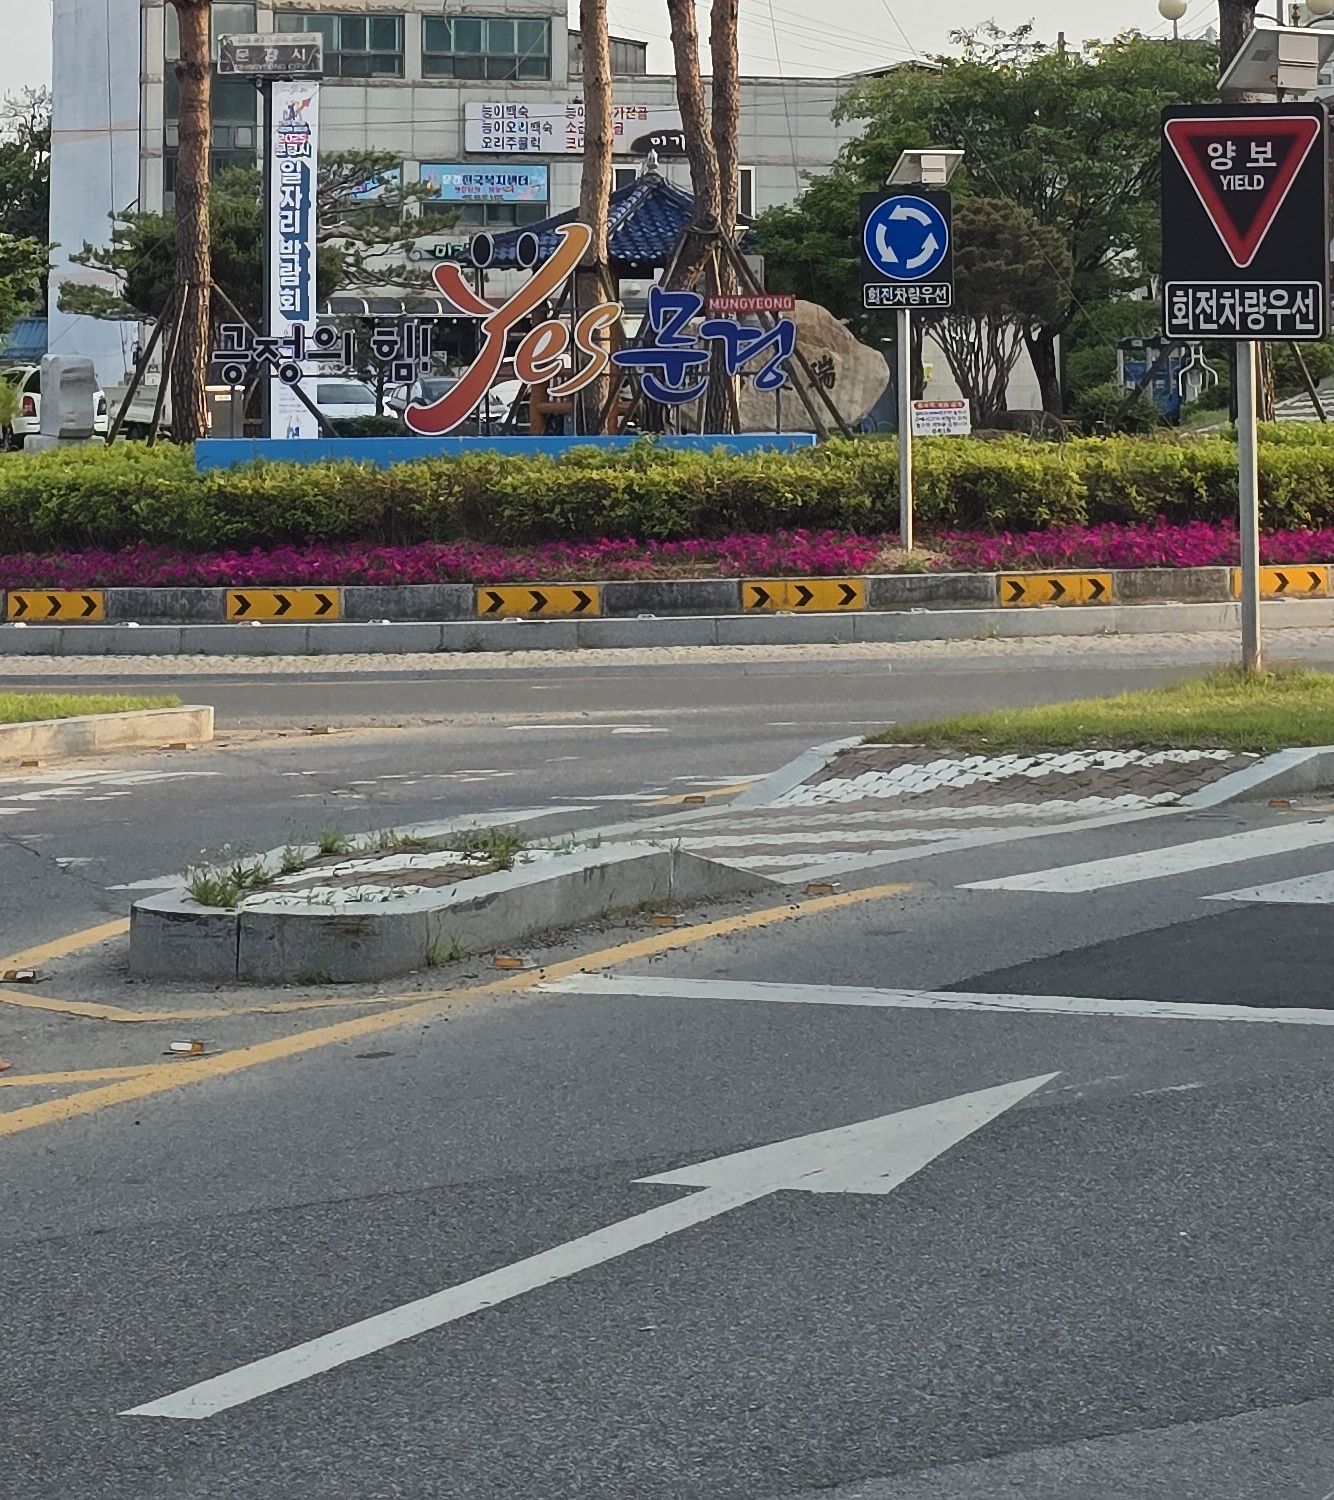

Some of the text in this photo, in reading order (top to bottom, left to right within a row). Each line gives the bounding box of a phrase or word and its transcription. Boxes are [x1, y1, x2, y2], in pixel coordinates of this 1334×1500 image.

[481, 104, 529, 119] 능이백숙
[1207, 140, 1277, 171] 양보
[1219, 174, 1265, 191] YIELD
[708, 296, 793, 310] MUNGYEONG
[868, 286, 947, 305] 회전차량우선
[1171, 288, 1315, 331] 회전차량우선
[404, 222, 622, 436] Yes
[611, 284, 797, 405] 문경
[212, 322, 432, 386] 긍정의 힘!
